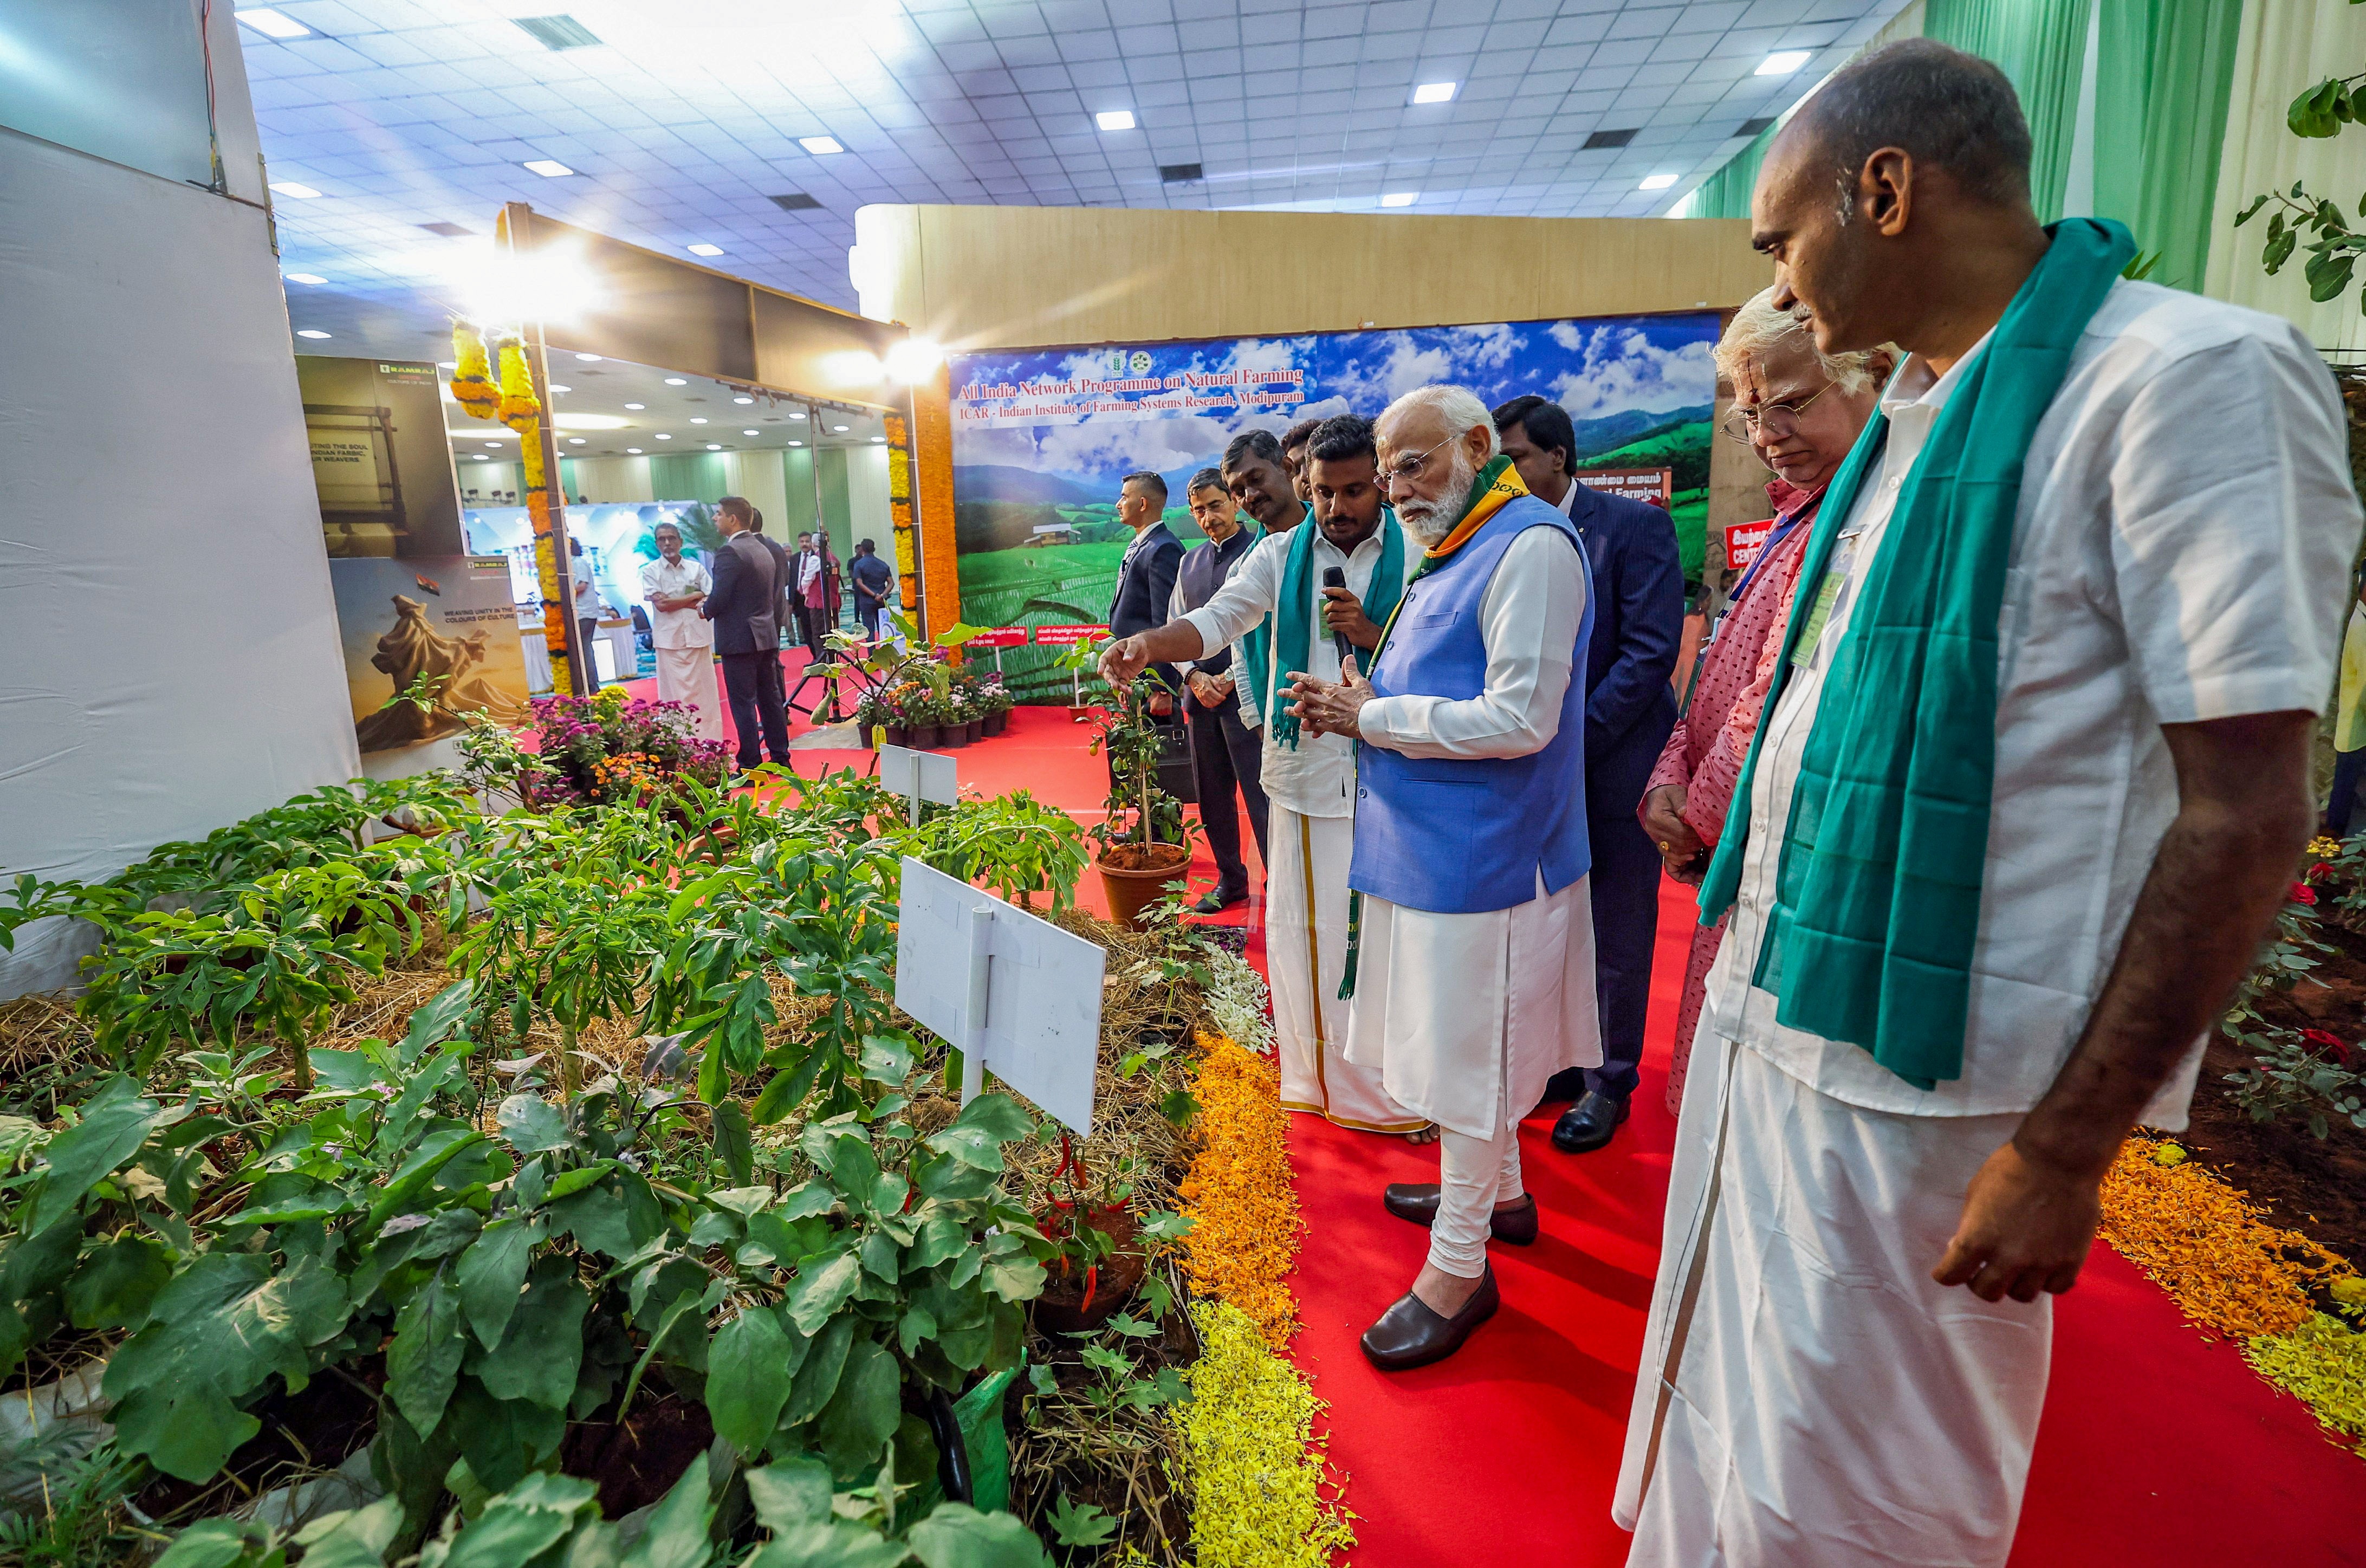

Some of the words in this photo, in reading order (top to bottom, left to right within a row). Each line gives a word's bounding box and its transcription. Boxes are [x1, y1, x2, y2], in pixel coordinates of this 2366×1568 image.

[960, 385, 977, 399] All
[982, 383, 1016, 398] India
[1020, 380, 1077, 396] Network
[1082, 378, 1160, 394] Programme
[1164, 377, 1180, 387] on
[1186, 371, 1237, 386] Natural
[1243, 367, 1303, 384] Farming
[960, 407, 988, 419] ICAR
[1000, 406, 1031, 417] Indian
[1035, 404, 1077, 415] Institute
[1080, 402, 1091, 412] of
[1094, 399, 1137, 412] Farming
[1140, 398, 1182, 411] Systems
[1185, 393, 1236, 408] Research,
[1240, 392, 1304, 407] Modipuram
[1627, 472, 1662, 484] மையம்
